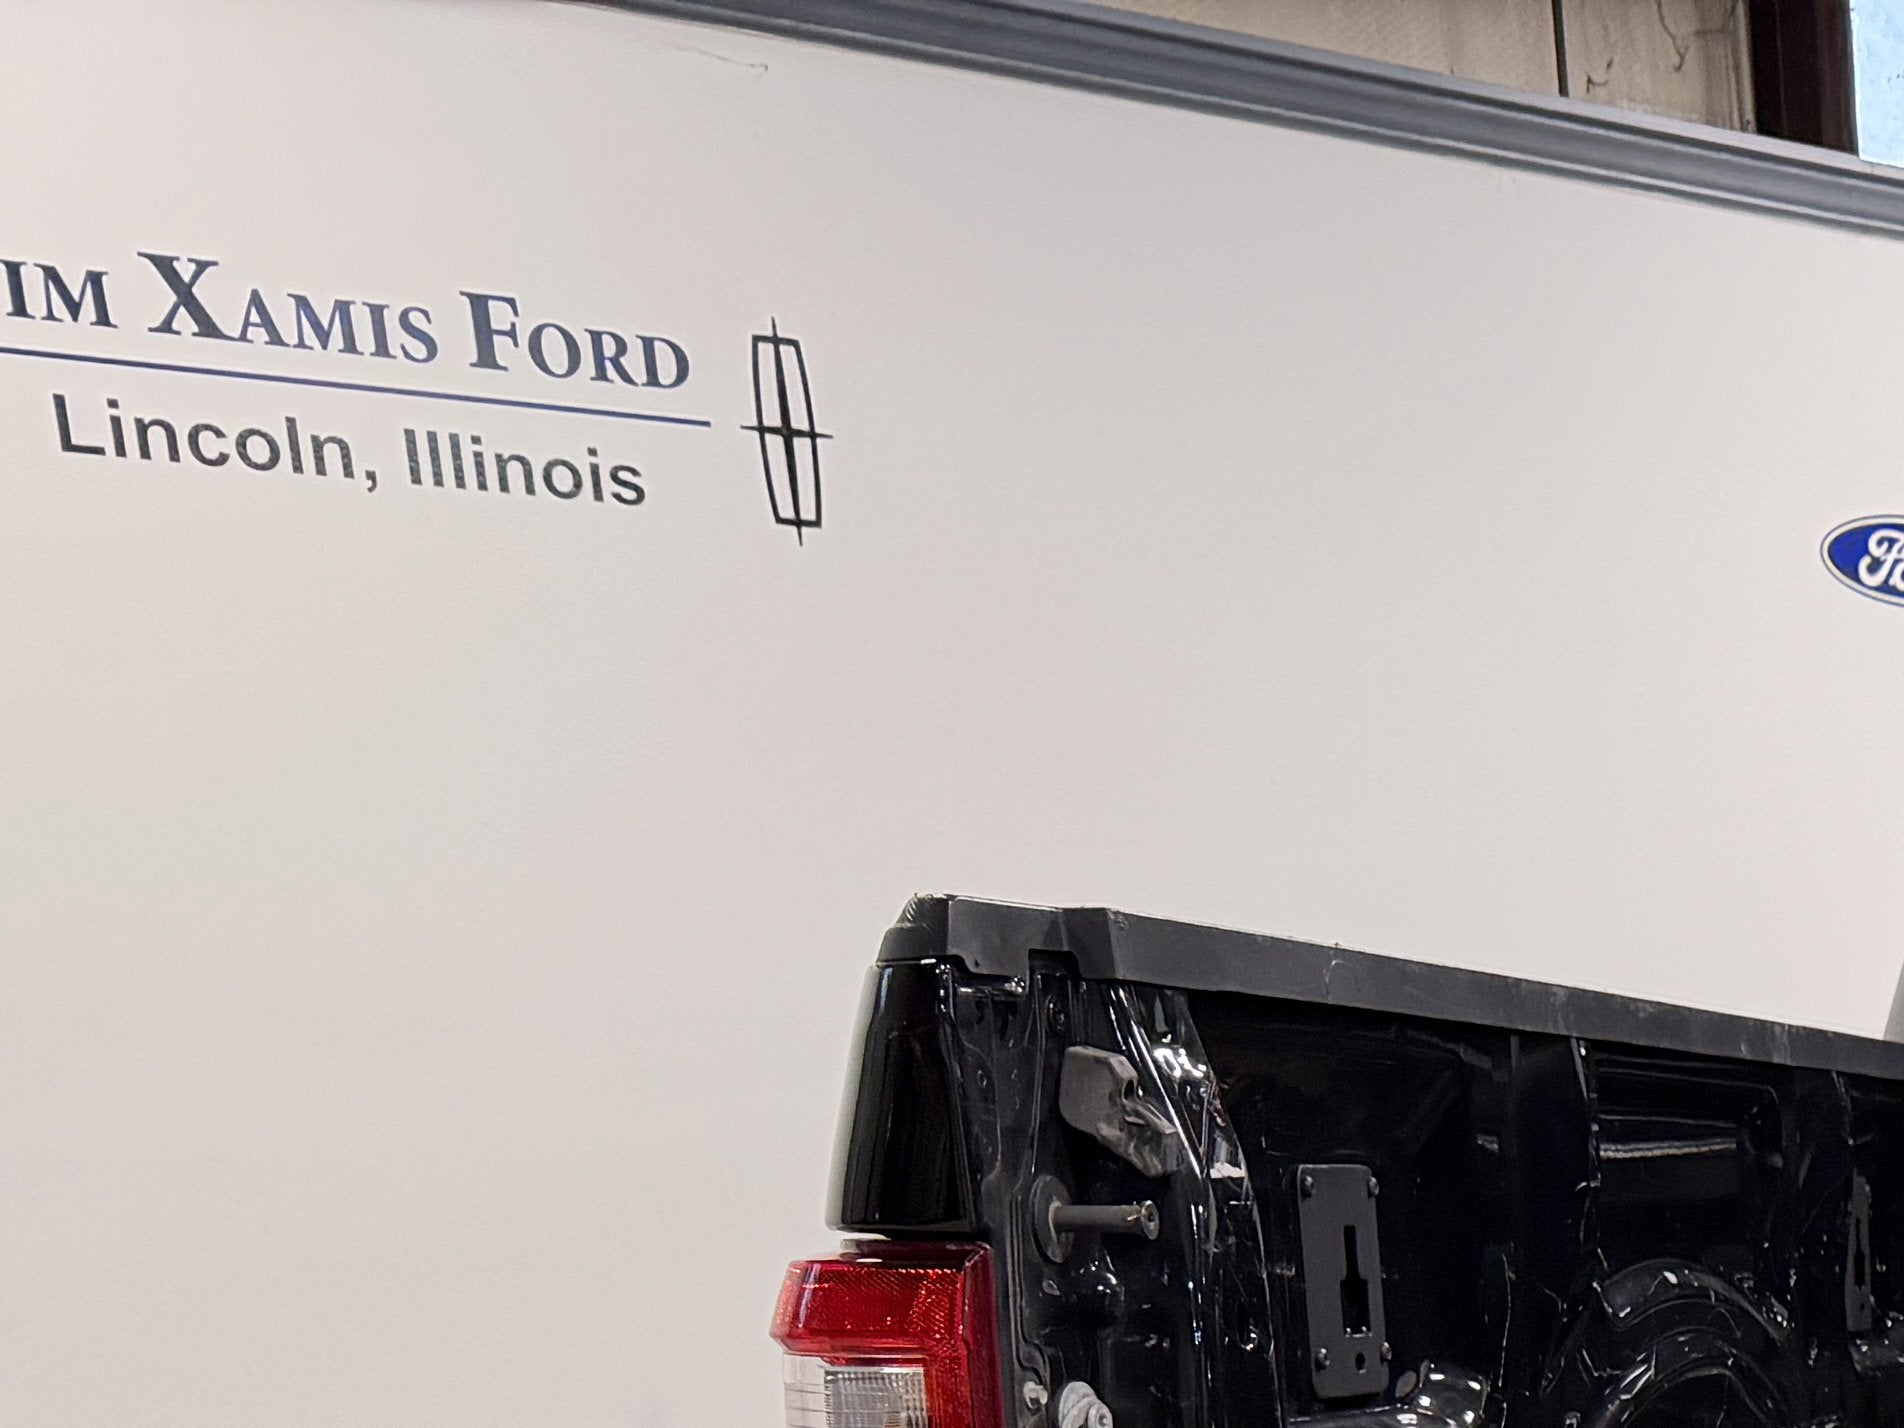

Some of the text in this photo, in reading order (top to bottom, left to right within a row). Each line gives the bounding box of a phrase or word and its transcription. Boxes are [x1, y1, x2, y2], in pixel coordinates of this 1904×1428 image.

[0, 251, 691, 390] IM XAMIS FORD
[52, 392, 647, 507] Lincoln, Illinois
